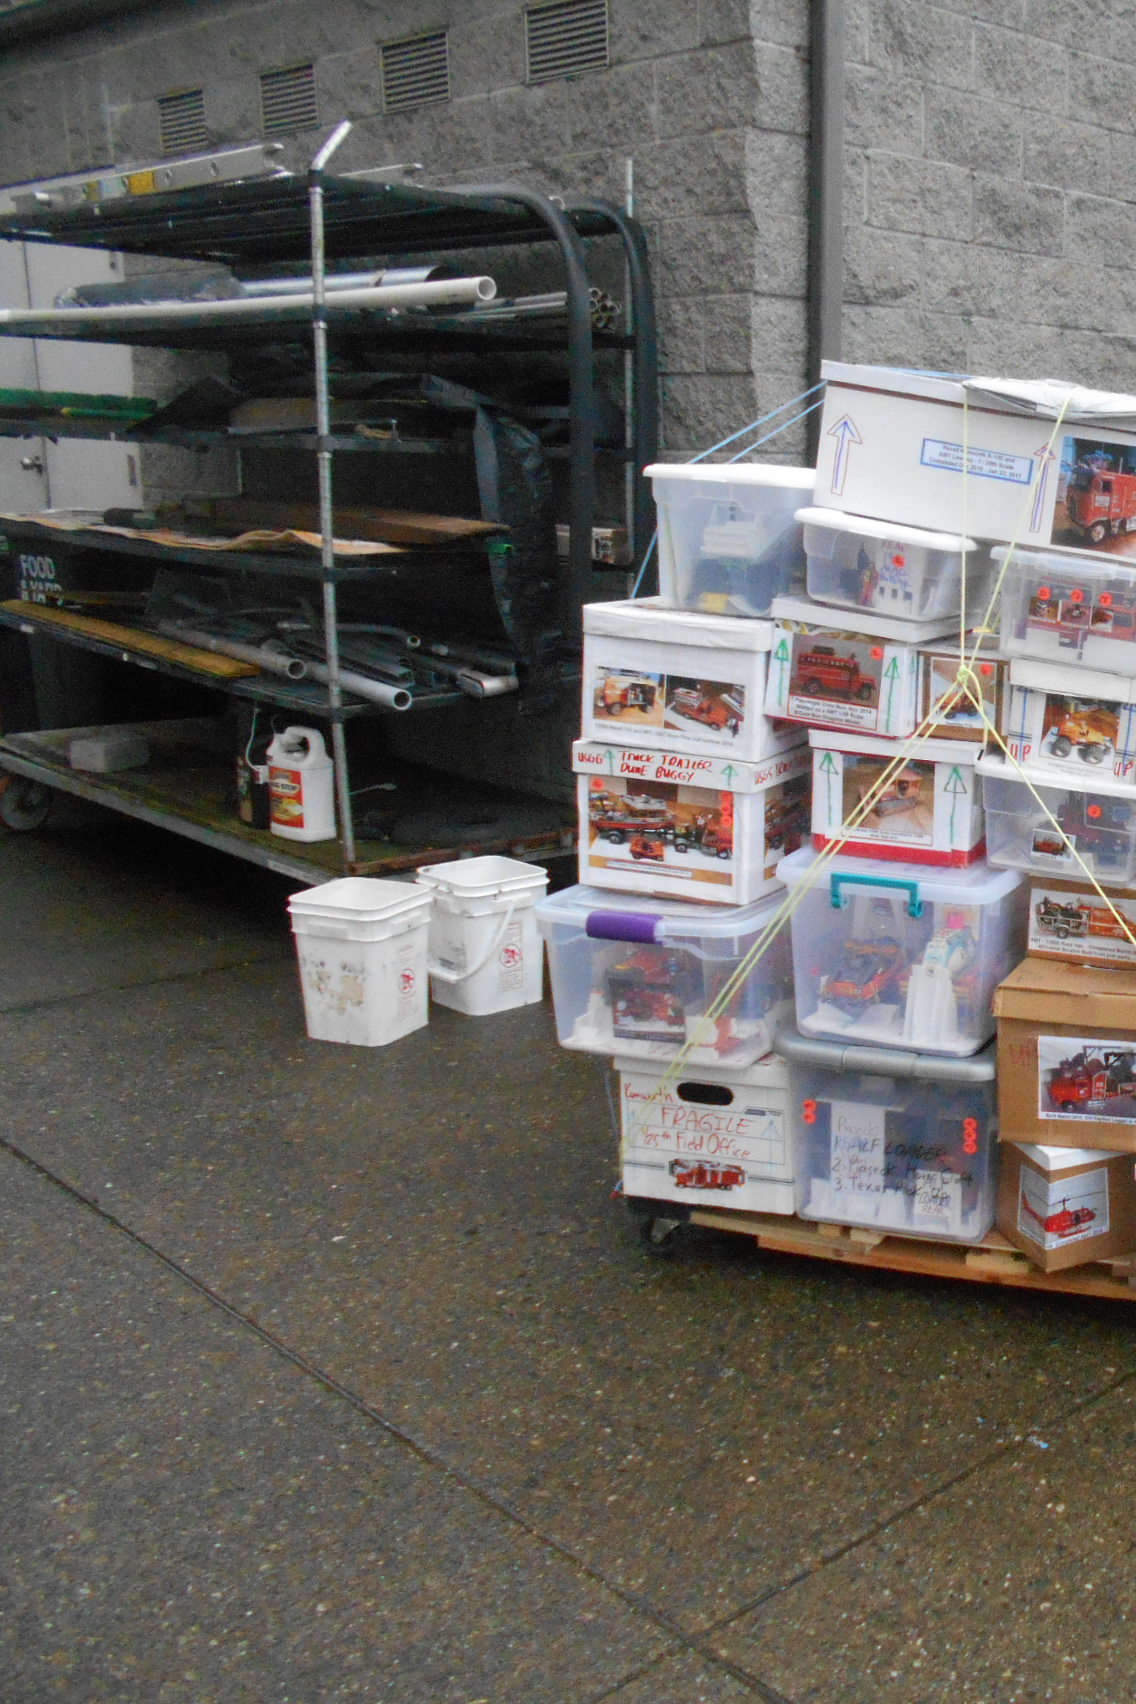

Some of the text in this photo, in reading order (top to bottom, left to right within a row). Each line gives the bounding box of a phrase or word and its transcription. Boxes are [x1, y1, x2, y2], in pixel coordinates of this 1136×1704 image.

[19, 554, 56, 579] FOOD
[1010, 743, 1033, 761] UP
[661, 754, 713, 772] TRAILER
[1114, 760, 1135, 777] UP
[655, 766, 696, 782] BUGGY
[661, 1106, 756, 1135] FRAGILE
[675, 1131, 704, 1151] Field
[706, 1132, 750, 1158] Office
